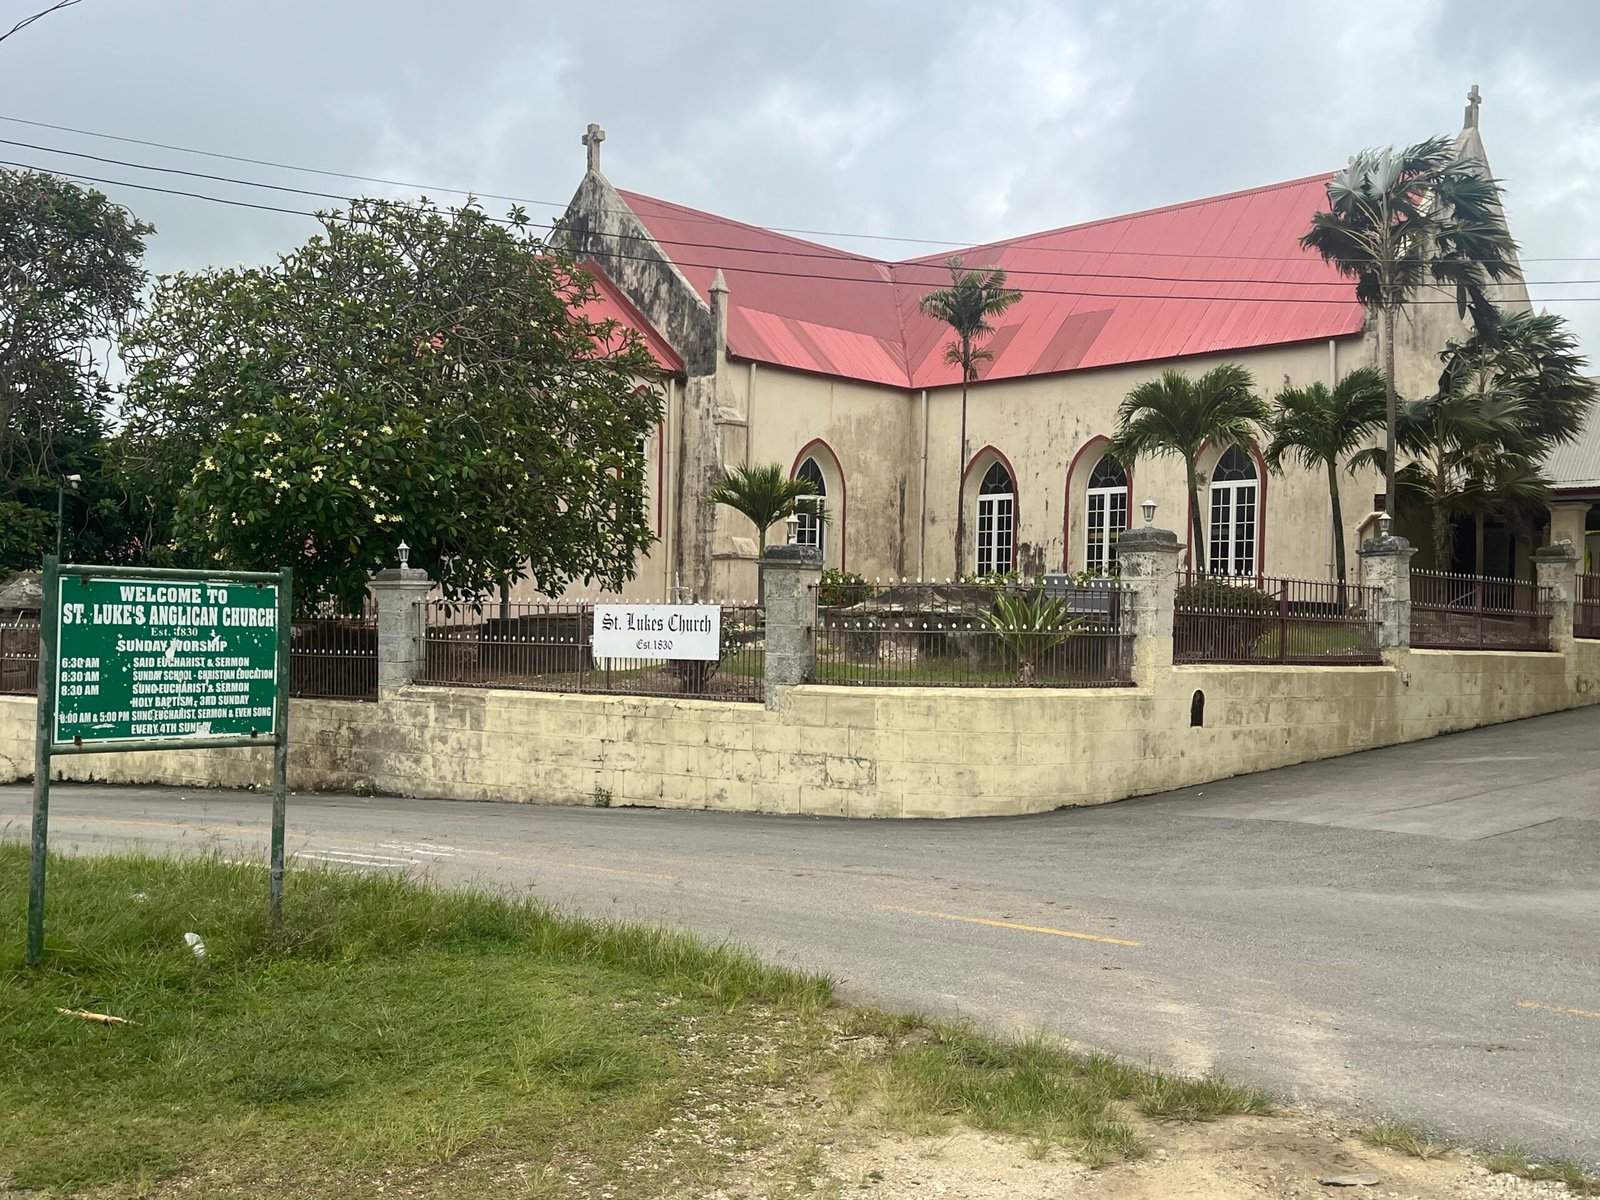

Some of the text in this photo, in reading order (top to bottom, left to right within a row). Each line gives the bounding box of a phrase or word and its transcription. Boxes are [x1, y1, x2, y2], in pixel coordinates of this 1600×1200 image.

[120, 586, 228, 604] WELCOME TO
[63, 604, 275, 627] ST. LUKE'S ANGLICAN CHURCH
[602, 612, 711, 635] St. Lukes Church
[151, 628, 198, 636] Est. 1830
[117, 640, 228, 652] SUNDAY WORSHIP
[62, 657, 250, 668] 6:30 AM SAID EUCHARIST & SERMON
[61, 671, 83, 682] 8:30
[84, 671, 99, 681] AM
[133, 670, 162, 681] SUNDAY
[163, 670, 192, 680] SCHOOL
[197, 670, 235, 680] CHRISTIAN
[236, 669, 273, 679] EDUCATION
[61, 682, 250, 696] 8:30 AM SUNG EUCHARIST & SERMON
[132, 697, 153, 707] HOLY
[155, 696, 193, 707] BAPTISM
[199, 695, 217, 706] 3RD
[218, 695, 250, 705] SUNDAY
[79, 712, 91, 723] AM
[92, 713, 98, 722] &
[99, 712, 117, 722] 5:00
[118, 711, 129, 721] PM
[197, 708, 227, 718] SERMON
[228, 709, 233, 718] &
[235, 708, 252, 717] EVEN
[253, 707, 272, 717] SONG
[131, 723, 158, 734] EVERY
[159, 723, 177, 733] 4TH
